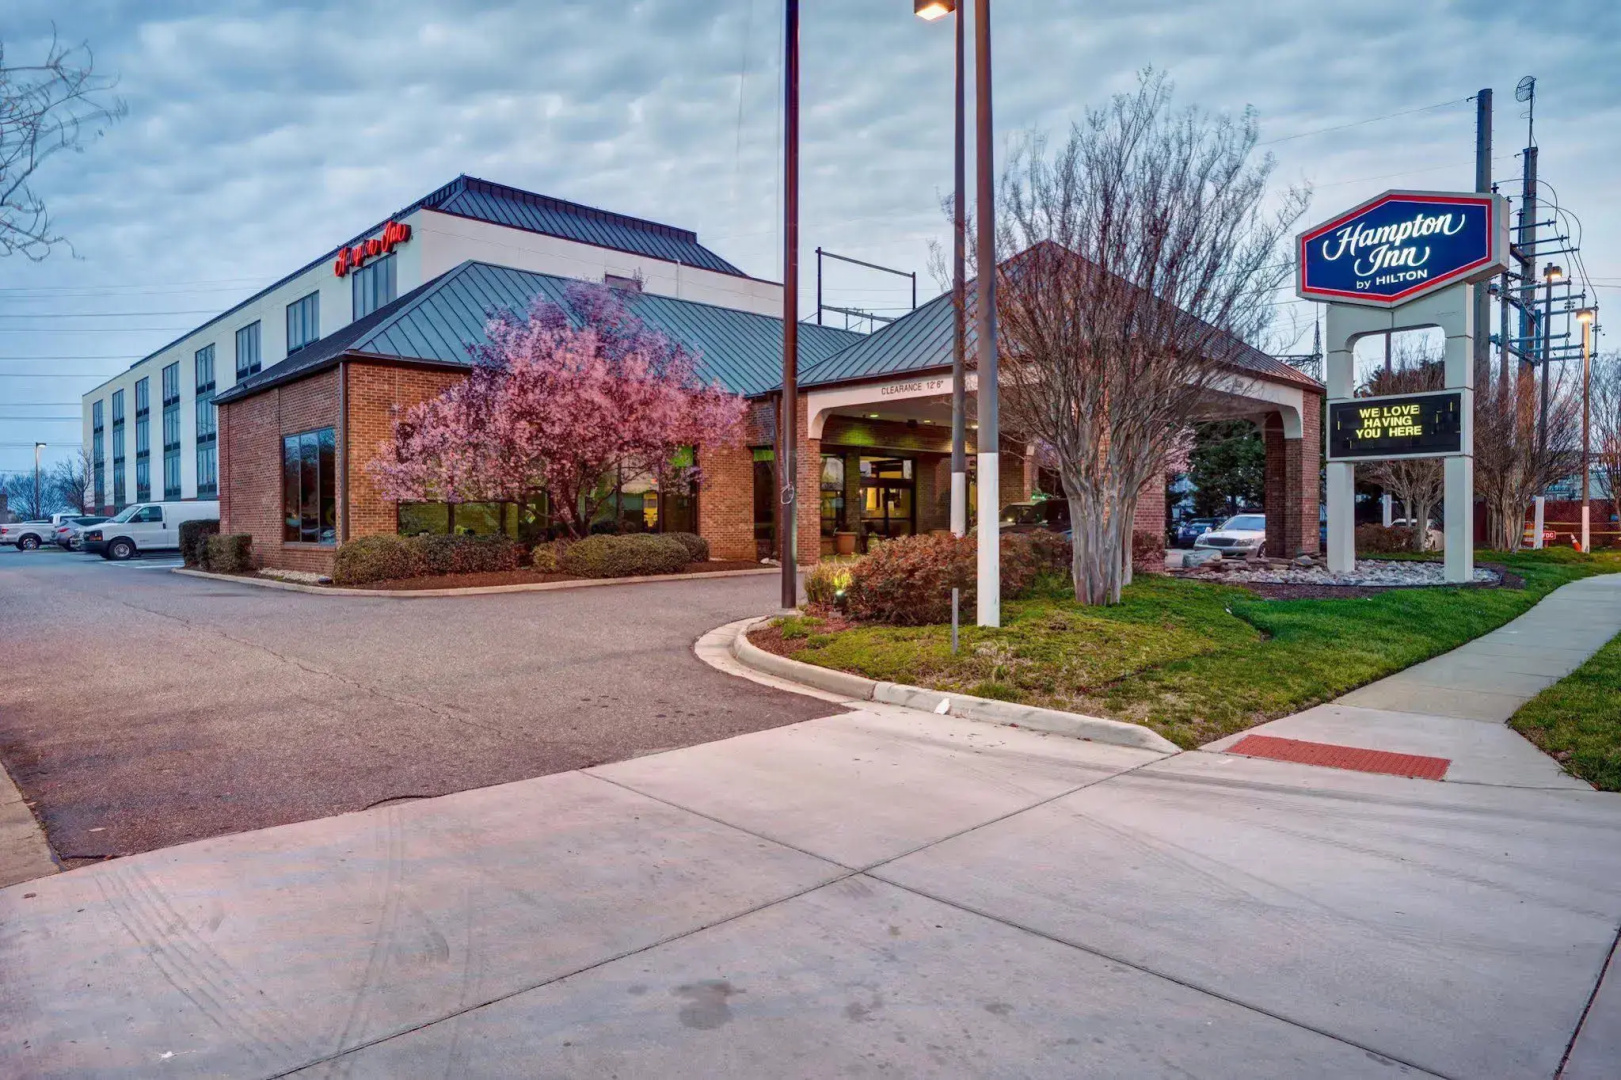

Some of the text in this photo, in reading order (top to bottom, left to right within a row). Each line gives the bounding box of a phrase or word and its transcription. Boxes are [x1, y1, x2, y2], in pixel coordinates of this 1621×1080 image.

[1322, 213, 1466, 261] Hampton
[1354, 244, 1430, 277] Inn
[1356, 269, 1428, 290] by HILTON
[881, 383, 922, 395] CLEARANCE
[1359, 404, 1420, 419] WE LOVE
[1363, 416, 1413, 428] HAVING
[1356, 425, 1423, 439] YOU HERE
